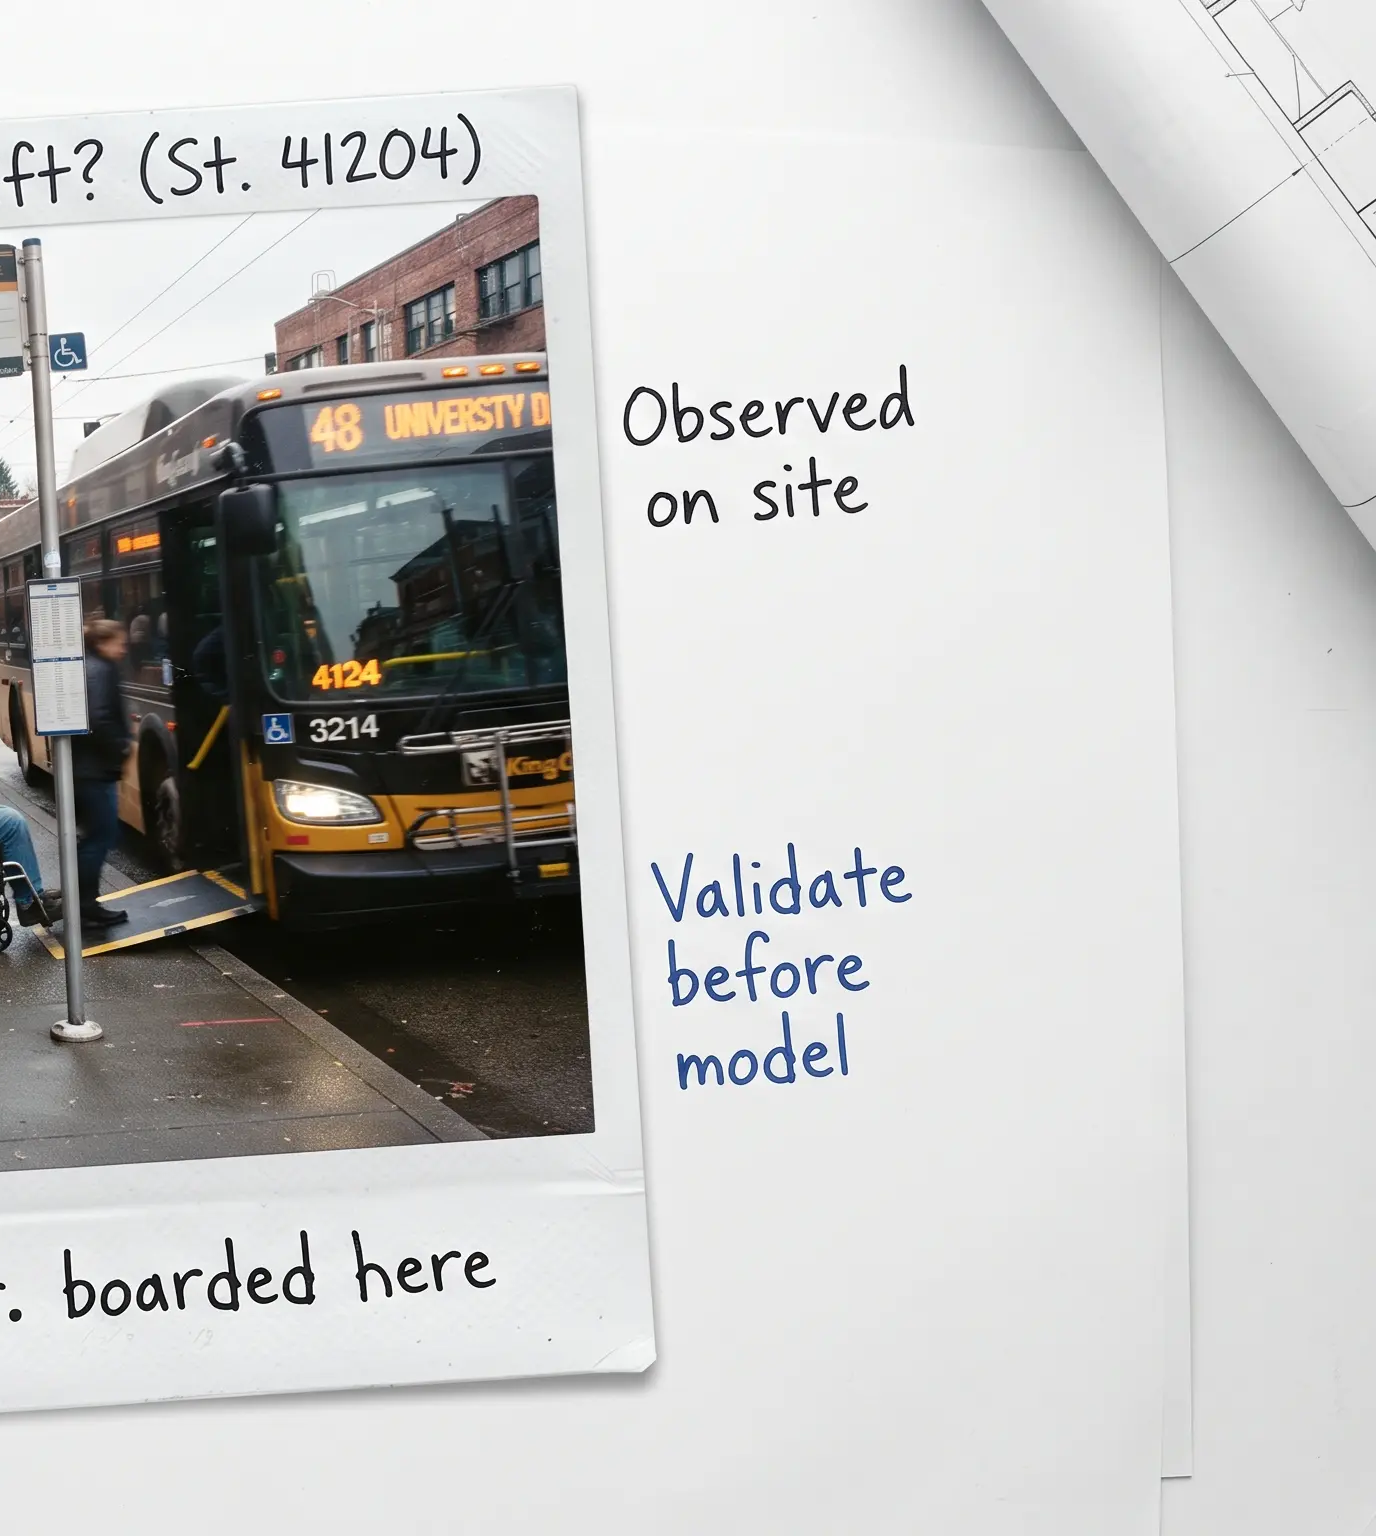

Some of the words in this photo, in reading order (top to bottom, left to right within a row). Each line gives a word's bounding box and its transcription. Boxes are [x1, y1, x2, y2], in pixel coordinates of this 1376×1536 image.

[140, 132, 252, 205] (St.
[281, 113, 482, 188] 41204)
[309, 403, 364, 453] 48
[384, 393, 525, 441] UNIVERSTY
[623, 364, 915, 447] Observed
[647, 488, 720, 528] on
[754, 456, 869, 521] site
[311, 659, 382, 690] 4124
[309, 714, 380, 743] 3214
[651, 842, 913, 923] Validate
[667, 931, 871, 1007] before
[676, 1011, 849, 1091] model
[62, 1230, 316, 1320] boarded
[352, 1230, 497, 1303] here
